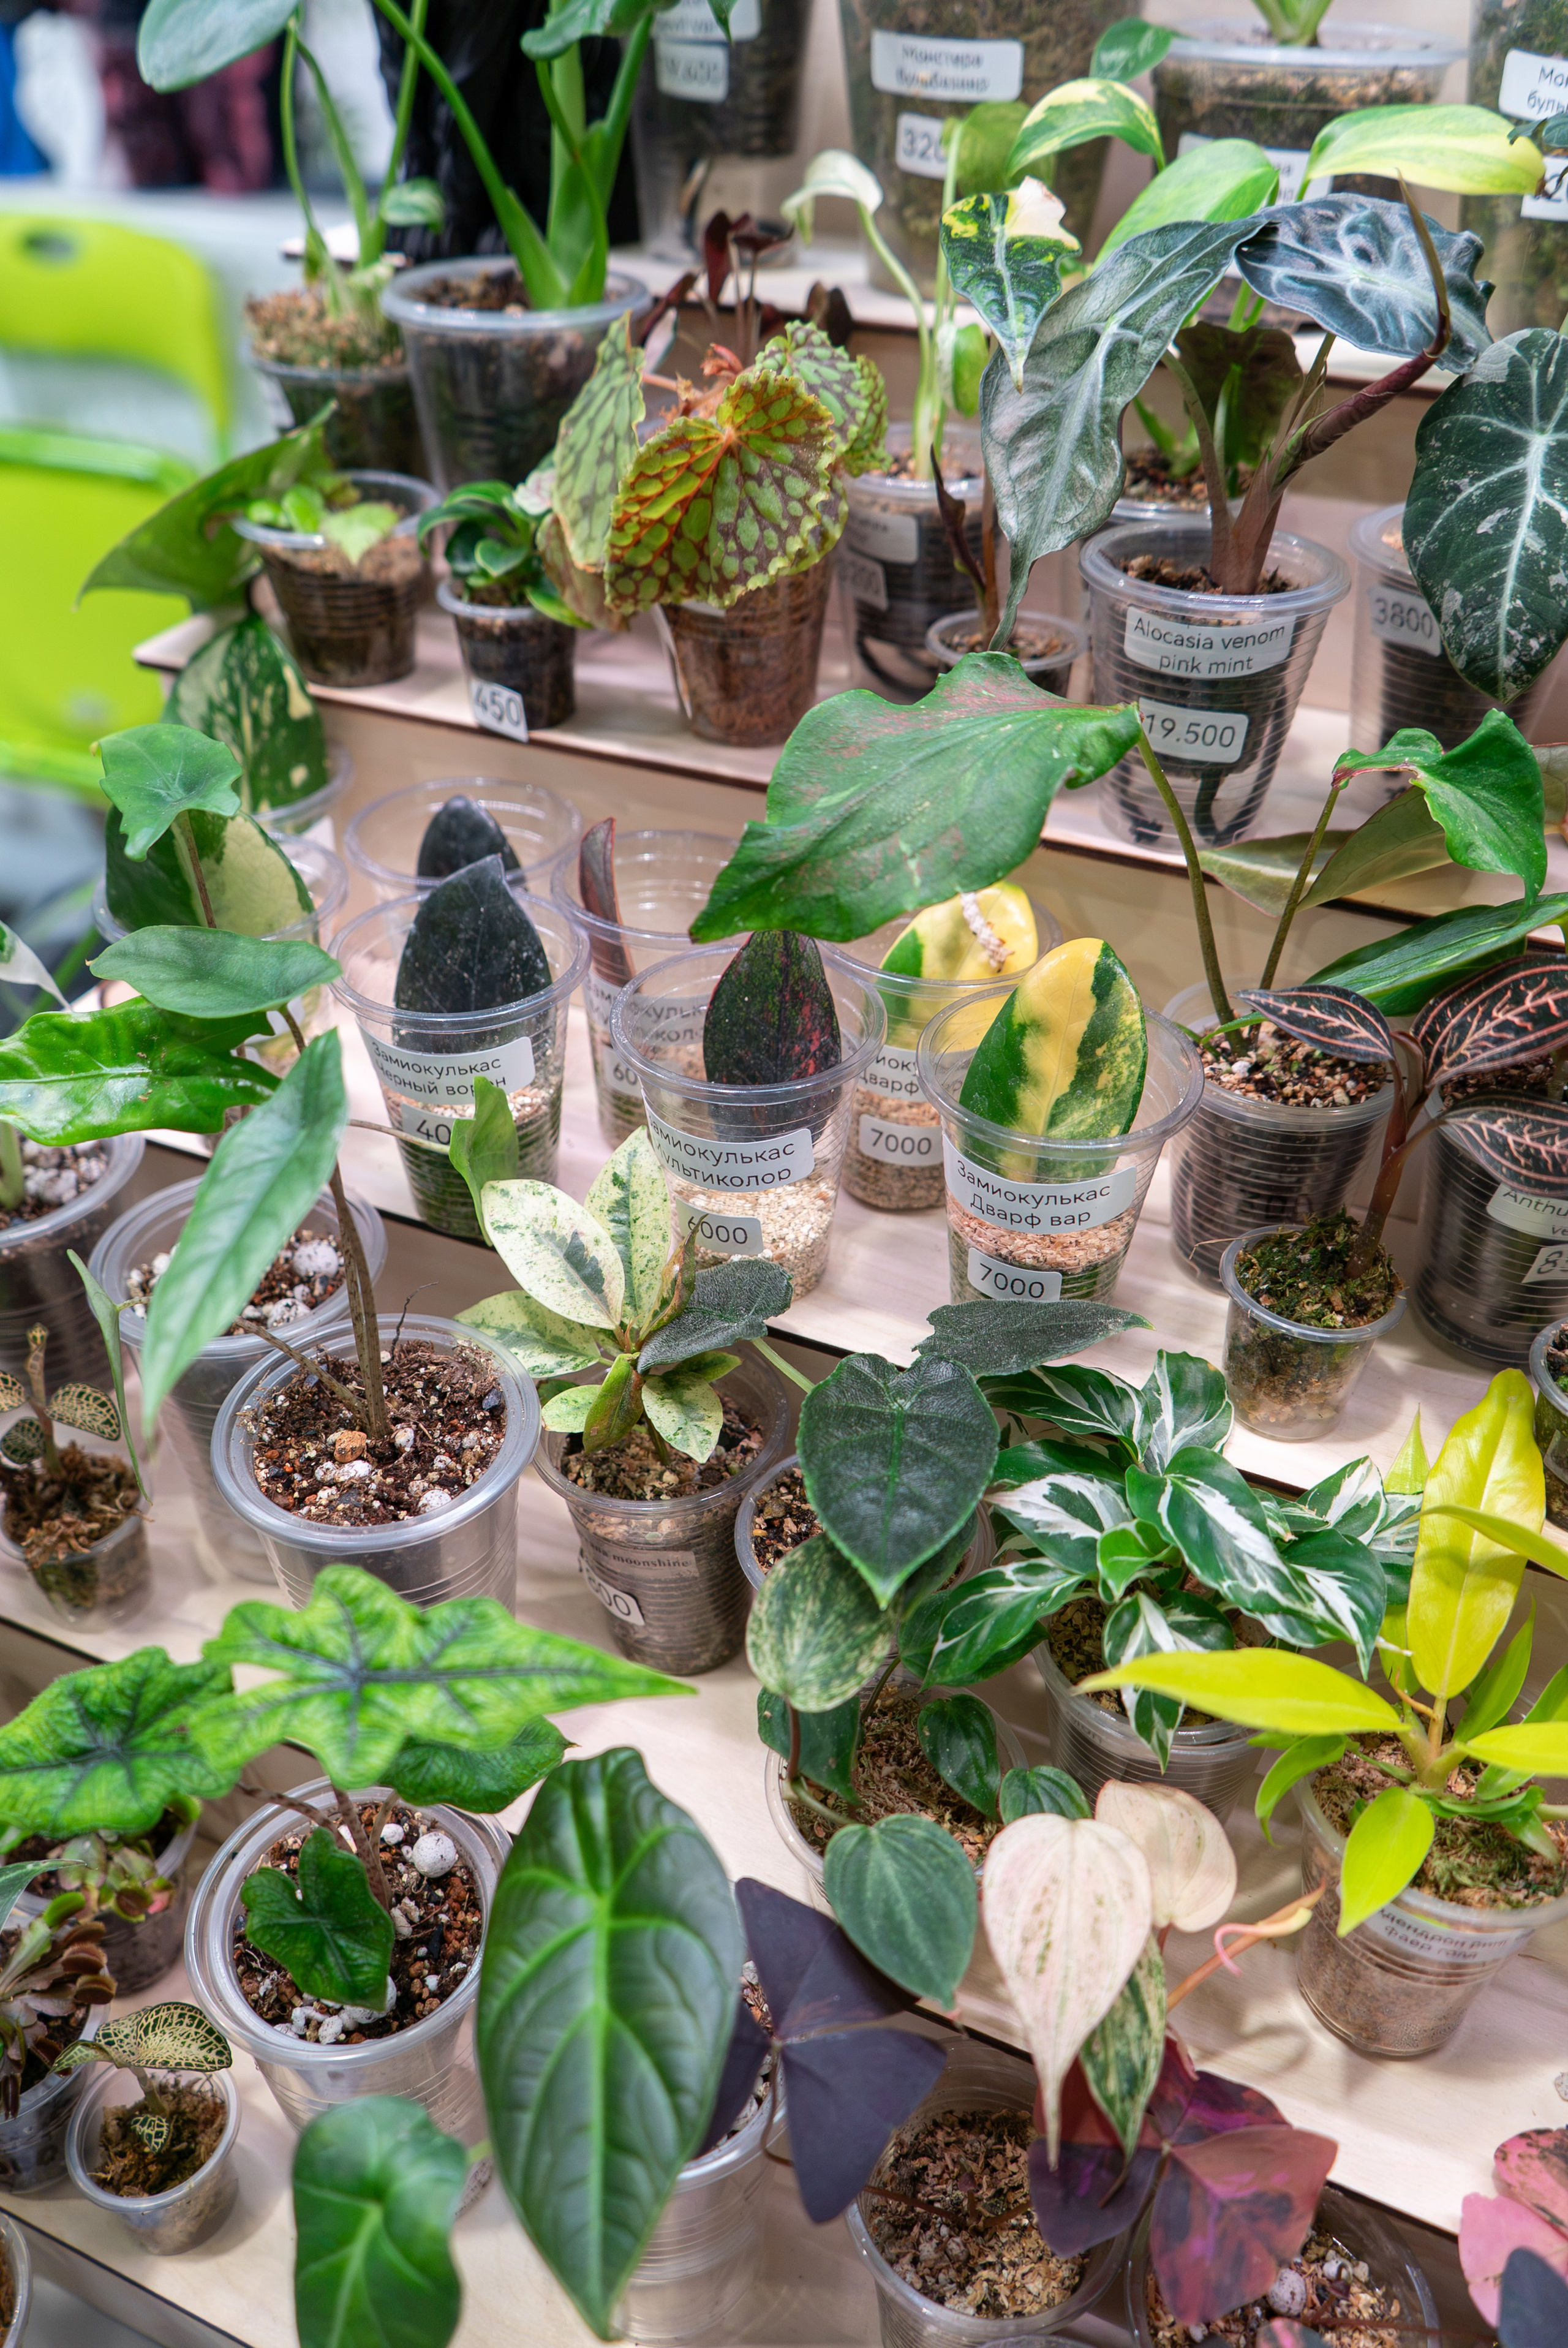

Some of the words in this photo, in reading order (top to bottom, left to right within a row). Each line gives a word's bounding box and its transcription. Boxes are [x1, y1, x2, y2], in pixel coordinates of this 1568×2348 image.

[1134, 617, 1213, 650] Alocasia
[1221, 625, 1285, 650] venom
[1374, 597, 1433, 639] 3800
[1159, 655, 1202, 674] pink
[1208, 655, 1253, 674] mint
[474, 684, 521, 727] 450
[1146, 714, 1236, 747] 19.500
[371, 1042, 501, 1079] Замиокулькас
[375, 1059, 439, 1095] Черный
[870, 1127, 932, 1155] 7000
[957, 1160, 1111, 1209] Замиокулькас
[970, 1193, 1041, 1229] Дварф
[1050, 1211, 1091, 1226] вар
[979, 1263, 1045, 1298] 7000
[612, 1553, 690, 1568] moonshine
